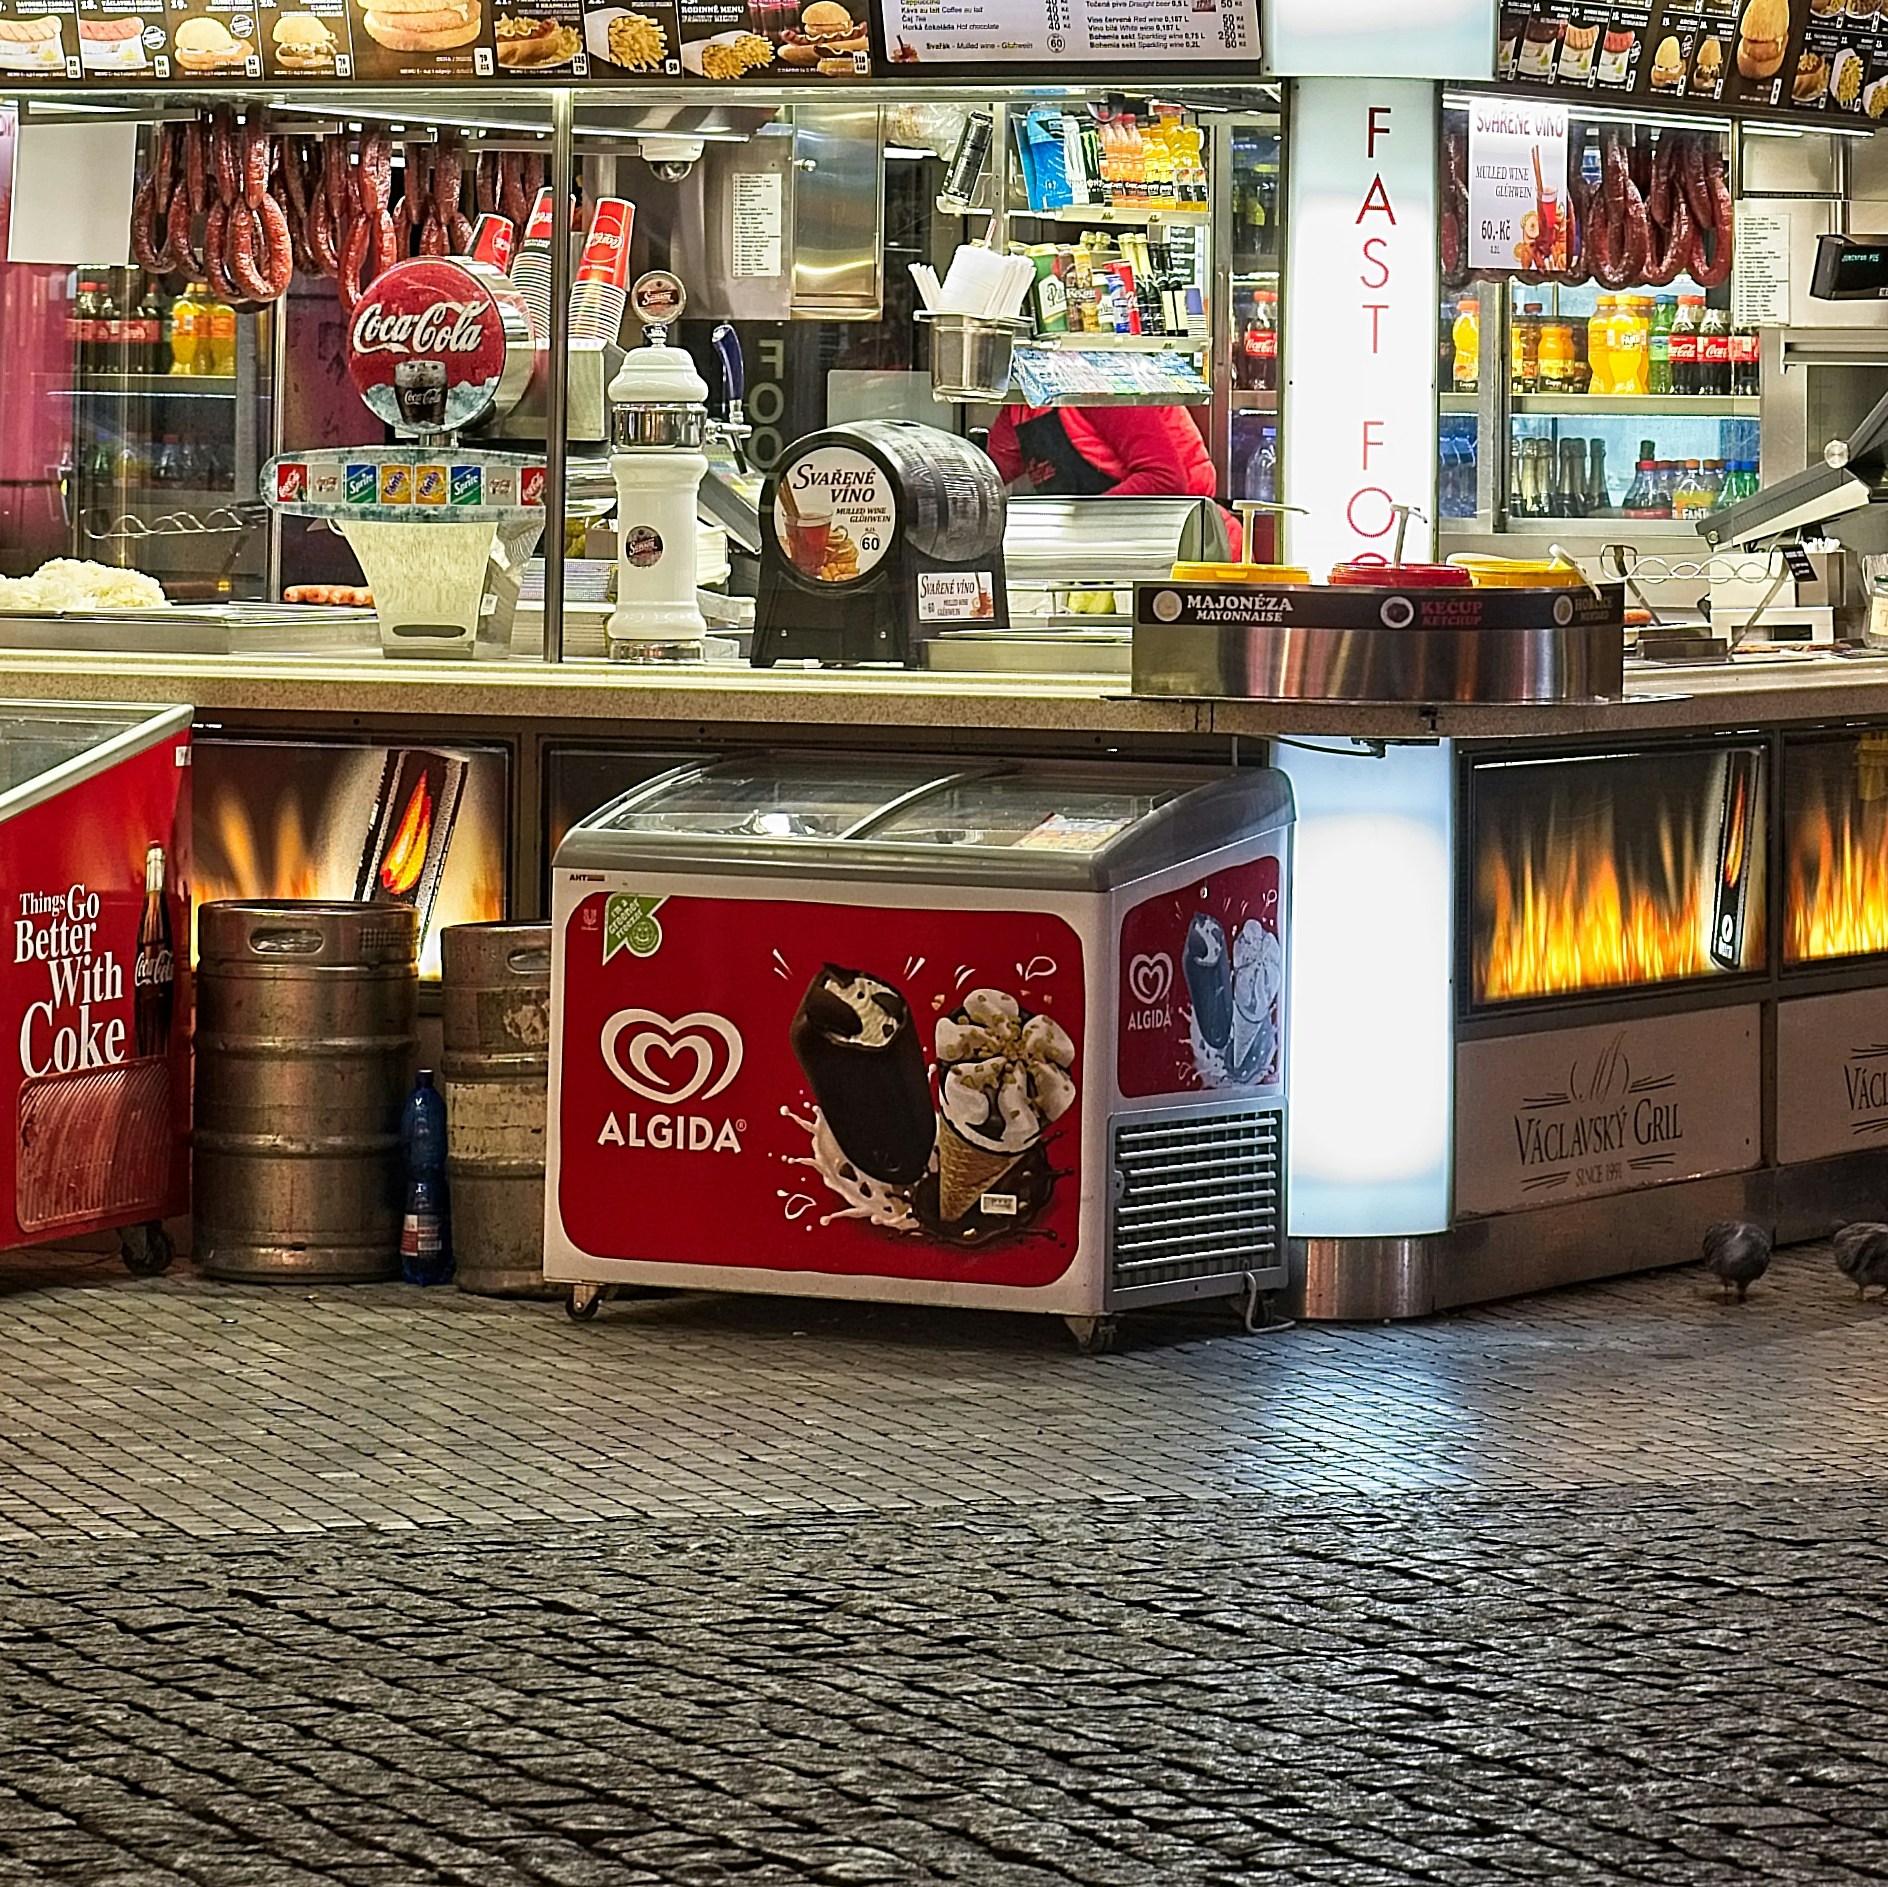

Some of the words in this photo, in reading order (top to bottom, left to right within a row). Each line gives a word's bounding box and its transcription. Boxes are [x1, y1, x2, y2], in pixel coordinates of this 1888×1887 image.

[1354, 105, 1397, 356] FAST
[352, 298, 490, 355] Coca-Cola
[348, 473, 374, 495] Sprite
[383, 470, 405, 497] Fanta
[418, 470, 440, 496] Fanta
[453, 473, 480, 495] Sprite
[793, 464, 876, 490] SVAŘENÉ
[830, 484, 876, 503] VÍNO
[850, 514, 891, 523] GLÜHWEIN
[862, 537, 880, 550] 60
[920, 575, 954, 598] SVAŘENÉ
[956, 579, 974, 593] VÍNO
[1187, 593, 1293, 612] MAJONÉZA
[1420, 598, 1483, 616] KEČUP
[1196, 610, 1283, 622] MAYONNAISE
[1422, 615, 1482, 627] KETCHUP
[569, 874, 588, 882] AHT
[20, 891, 65, 916] Things
[68, 884, 99, 921] Go
[14, 918, 96, 963] Better
[48, 952, 123, 1009] With
[135, 950, 174, 987] Coca-Cola
[1128, 1005, 1171, 1031] ALGIDA
[20, 1000, 125, 1078] Coke
[597, 1111, 742, 1154] ALGIDA
[1514, 1106, 1628, 1166] VÁCLAVSKÝ
[1633, 1097, 1683, 1146] GRIL
[1575, 1164, 1604, 1187] SINCE
